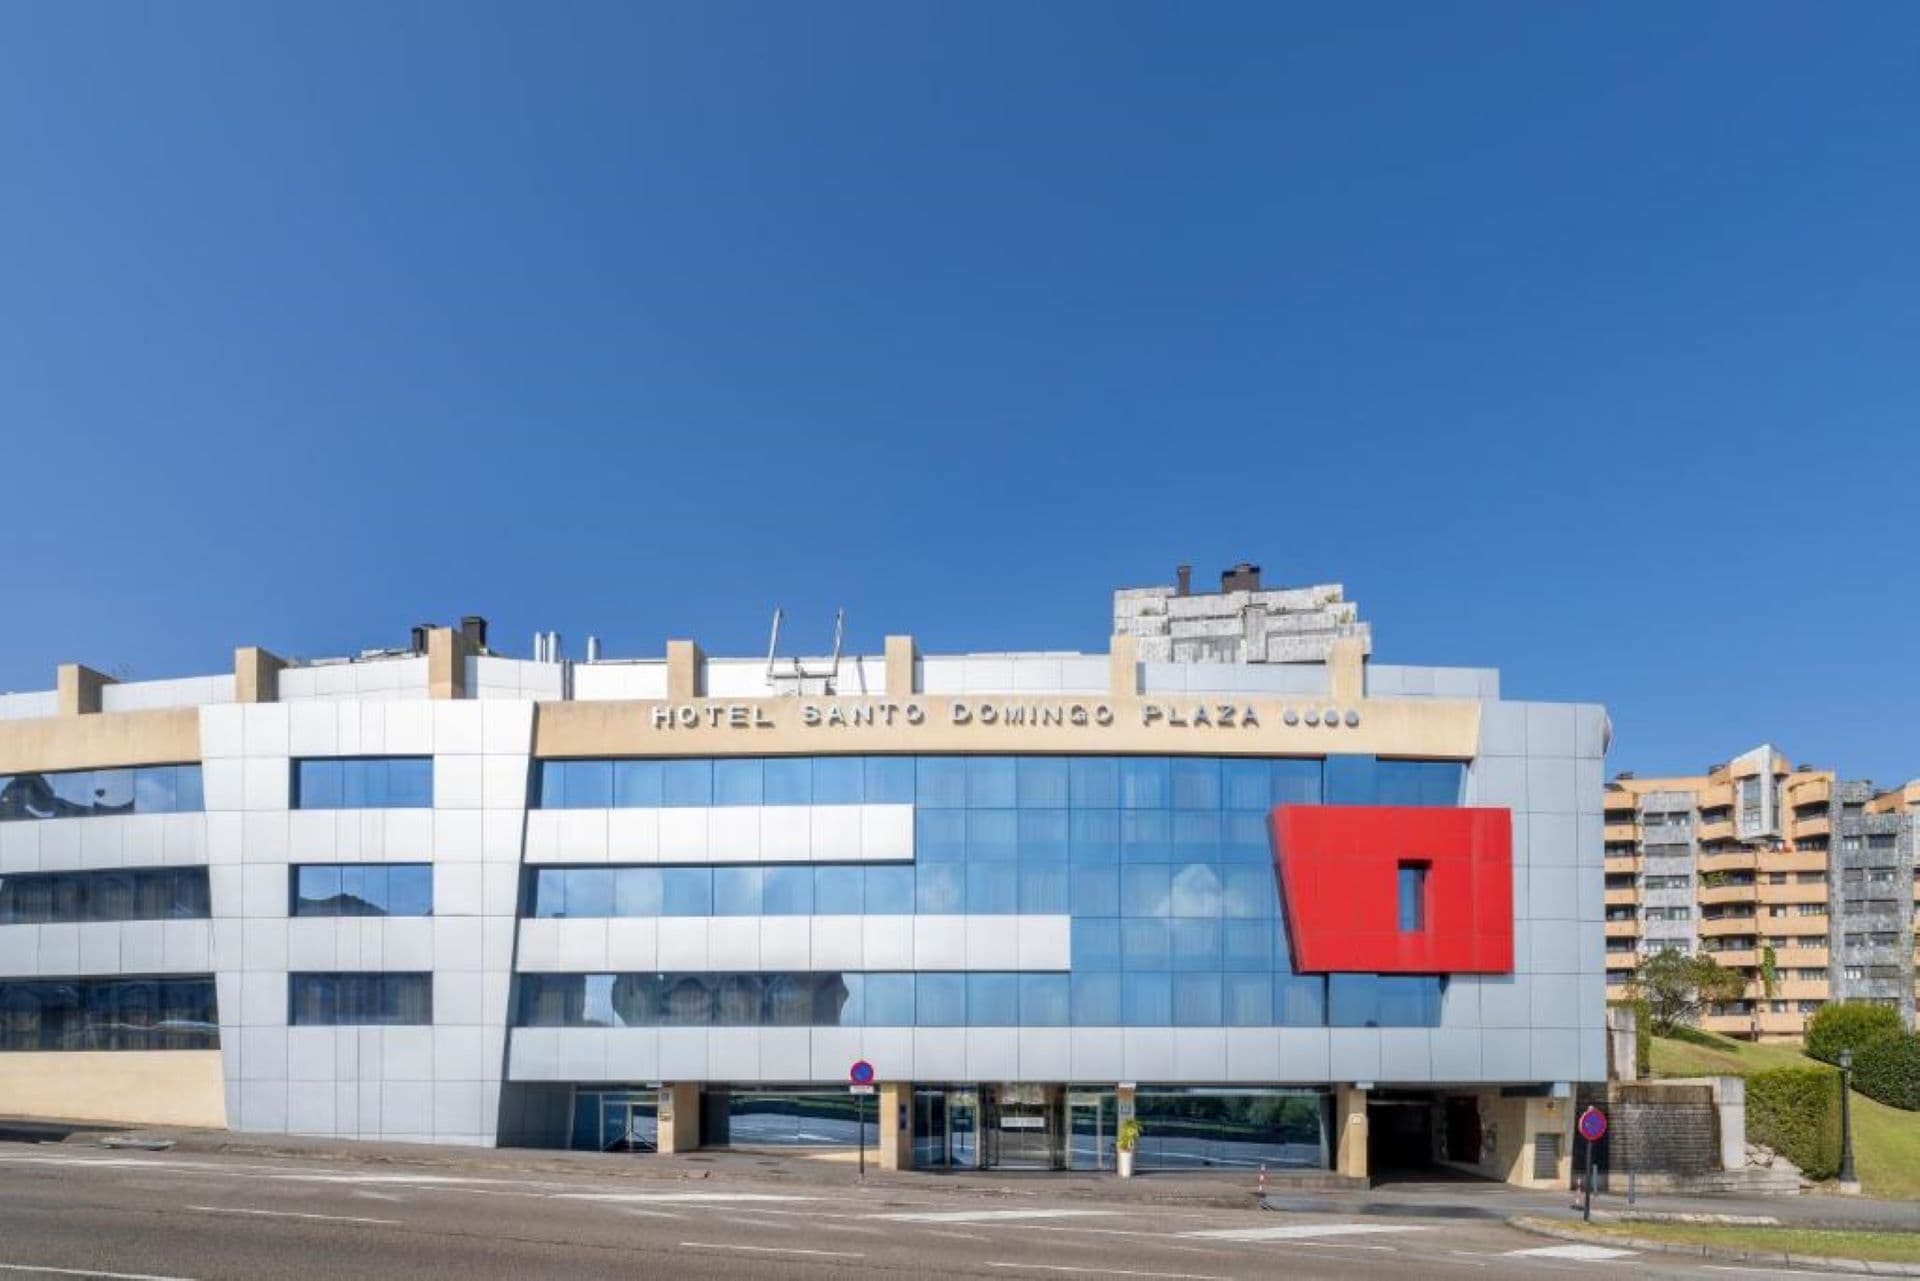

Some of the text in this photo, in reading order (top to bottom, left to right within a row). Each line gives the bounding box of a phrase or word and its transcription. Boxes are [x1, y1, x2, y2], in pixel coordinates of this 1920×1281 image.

[652, 704, 1260, 729] HOTEL SANTO DOMINGO PLAZA
